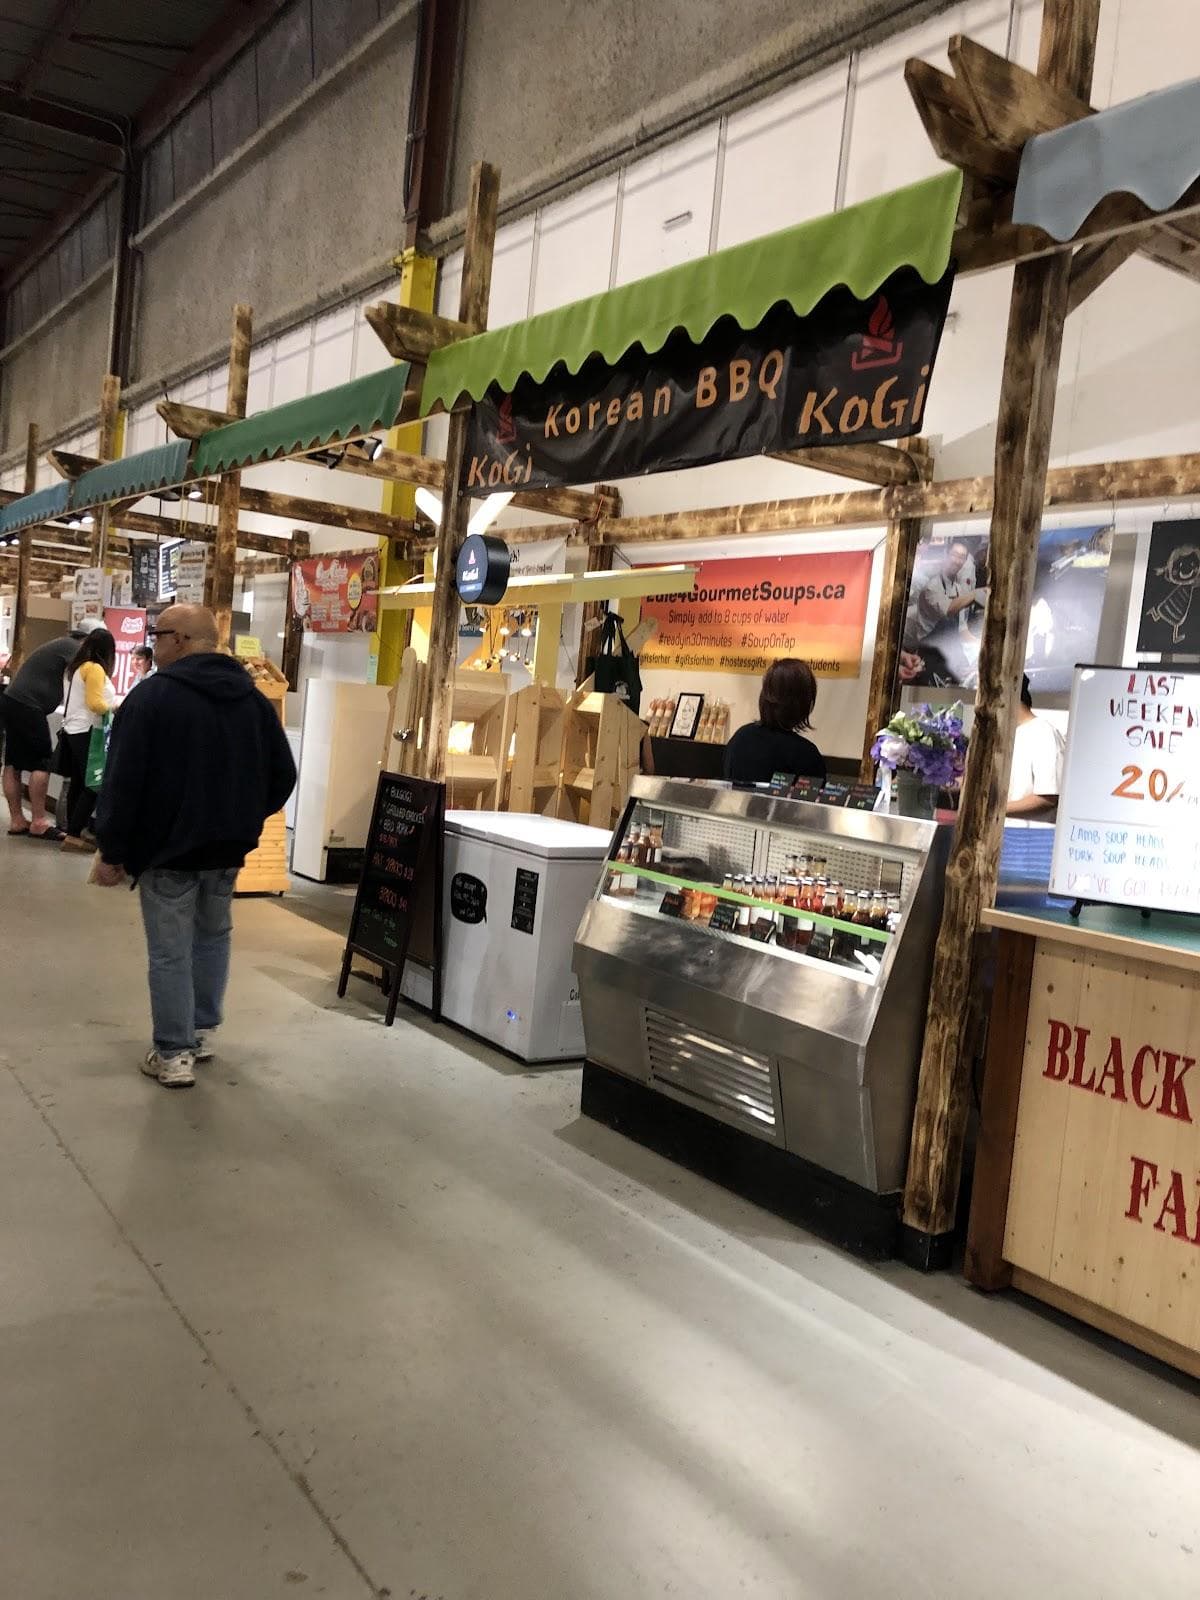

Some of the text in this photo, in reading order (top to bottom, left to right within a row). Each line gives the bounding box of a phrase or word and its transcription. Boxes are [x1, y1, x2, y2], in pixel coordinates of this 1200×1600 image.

[544, 349, 785, 439] Korean BBQ
[798, 365, 930, 434] KoGi
[467, 443, 534, 488] KoGi
[668, 609, 790, 627] Simply add to 8 cups of water
[1127, 674, 1184, 696] LAST
[1126, 725, 1183, 754] SALE
[1105, 831, 1128, 846] SOUP
[1103, 850, 1127, 865] SOUP
[1043, 1020, 1195, 1124] BLACK
